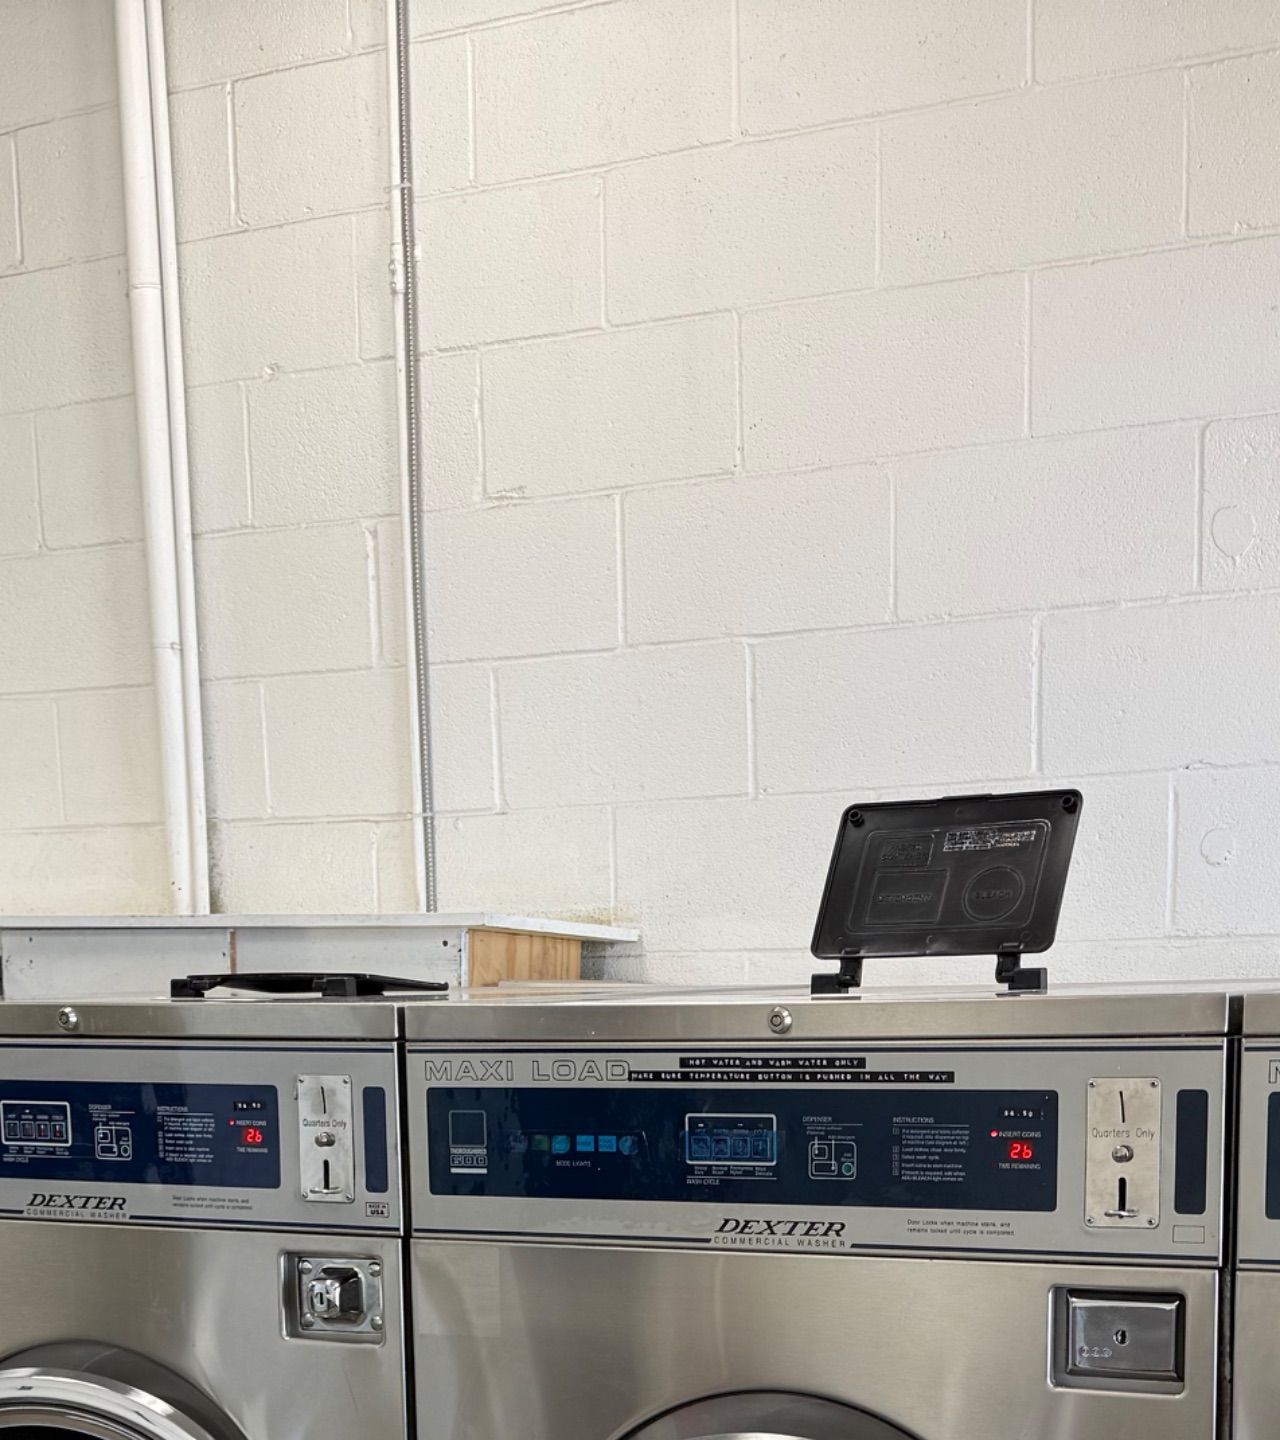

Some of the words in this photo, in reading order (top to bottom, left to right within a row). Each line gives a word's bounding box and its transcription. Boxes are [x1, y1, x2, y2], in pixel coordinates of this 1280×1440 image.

[689, 1058, 706, 1066] HOT
[798, 1059, 828, 1067] WATER
[424, 1060, 514, 1082] MAXI
[531, 1059, 631, 1082] LOAD
[631, 1072, 654, 1080] MAKE
[661, 1072, 682, 1080] SURE
[689, 1072, 750, 1081] TEMPERATURE
[758, 1073, 793, 1081] BUTTON
[799, 1073, 810, 1081] IS
[816, 1073, 852, 1081] PUSHED
[860, 1073, 870, 1081] IN
[877, 1073, 895, 1081] ALL
[904, 1073, 920, 1081] THE
[302, 1119, 330, 1128] Quarters
[332, 1119, 347, 1129] Only
[1091, 1128, 1130, 1138] Quarters
[1135, 1127, 1156, 1140] Only
[1010, 1143, 1032, 1159] 26
[27, 1193, 127, 1210] DEXTER
[26, 1209, 85, 1218] COMMERCIAL
[90, 1211, 127, 1219] WASHER
[714, 1218, 846, 1237] DEXTER
[714, 1237, 790, 1246] COMMERCIAL
[797, 1238, 846, 1248] WASHER
